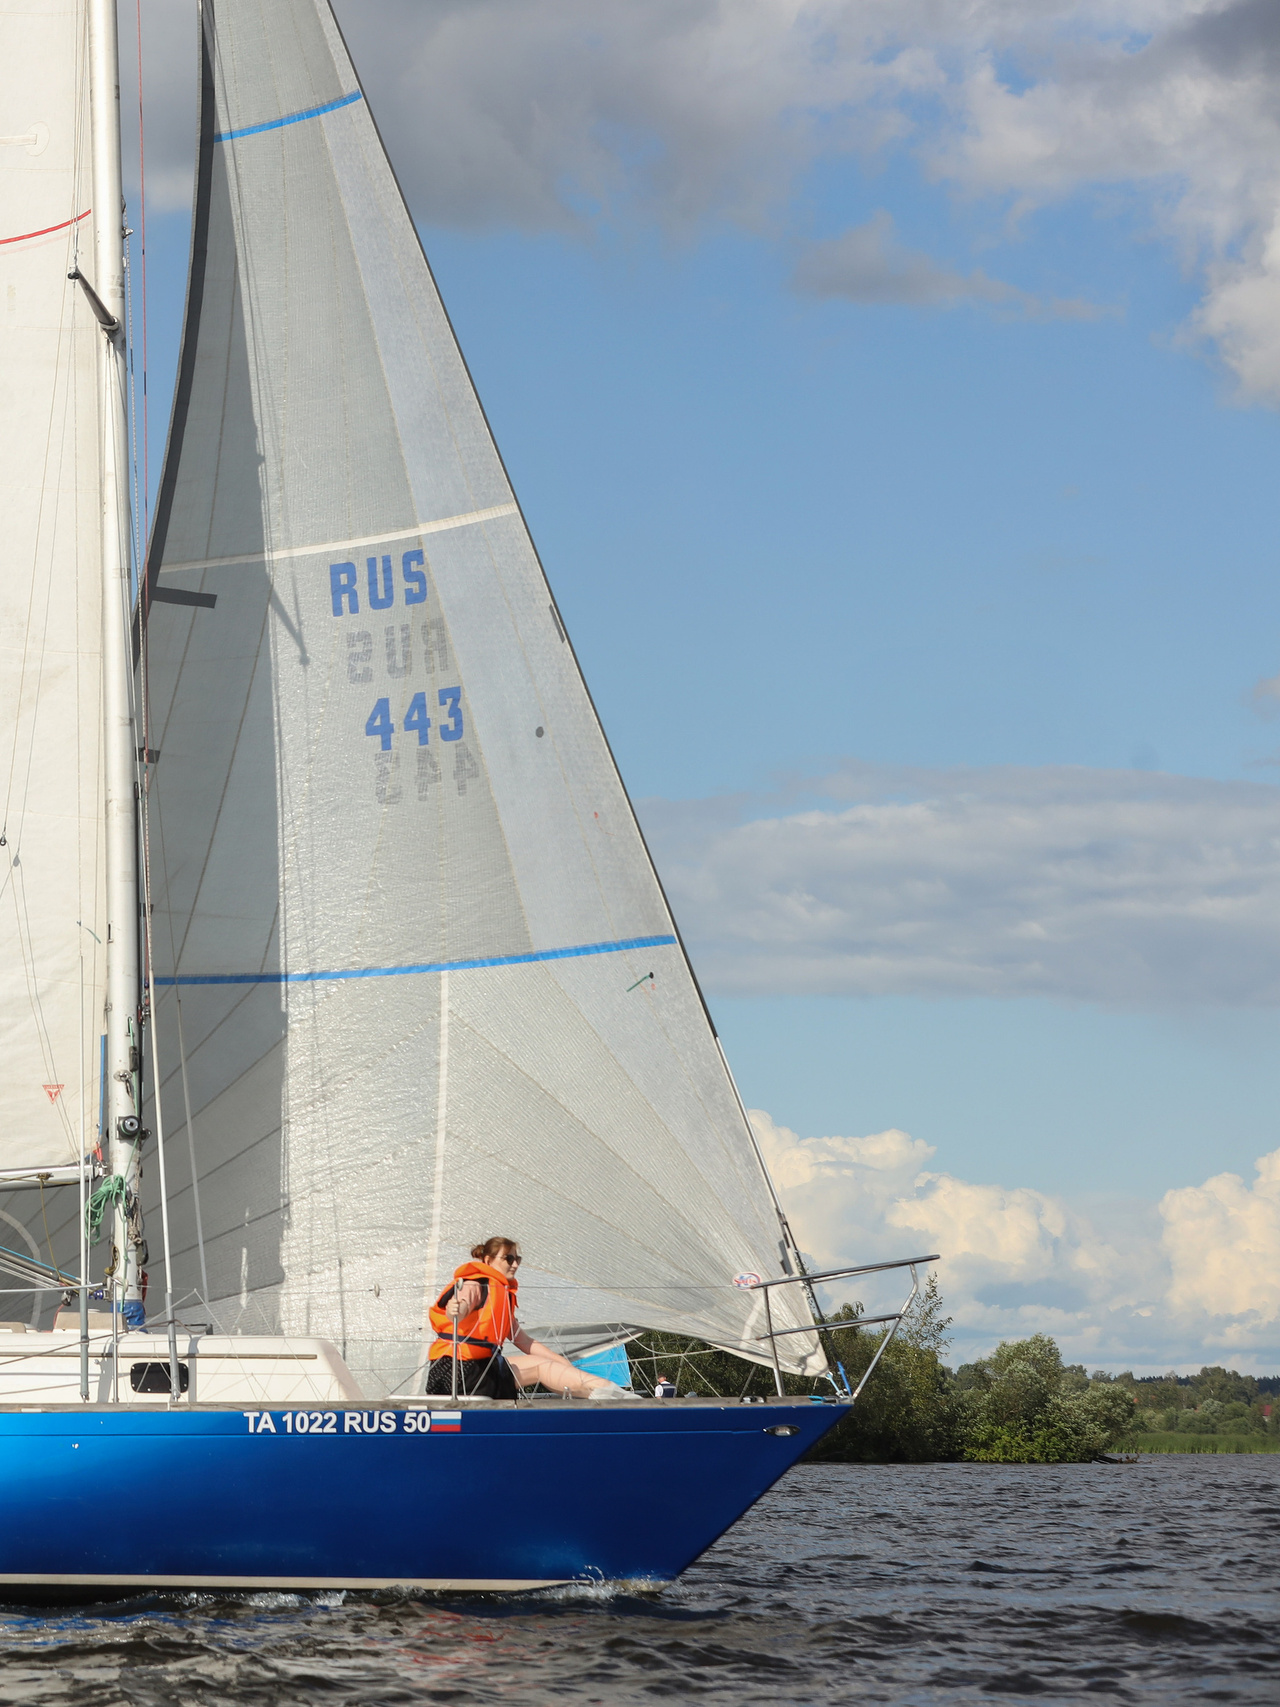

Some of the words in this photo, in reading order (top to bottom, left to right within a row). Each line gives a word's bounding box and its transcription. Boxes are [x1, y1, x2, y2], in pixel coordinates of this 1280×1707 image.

[329, 549, 428, 617] RUS
[365, 686, 464, 751] 443
[243, 1411, 276, 1433] TA
[282, 1411, 337, 1433] 1022
[344, 1411, 396, 1433] RUS
[403, 1411, 431, 1433] 50
